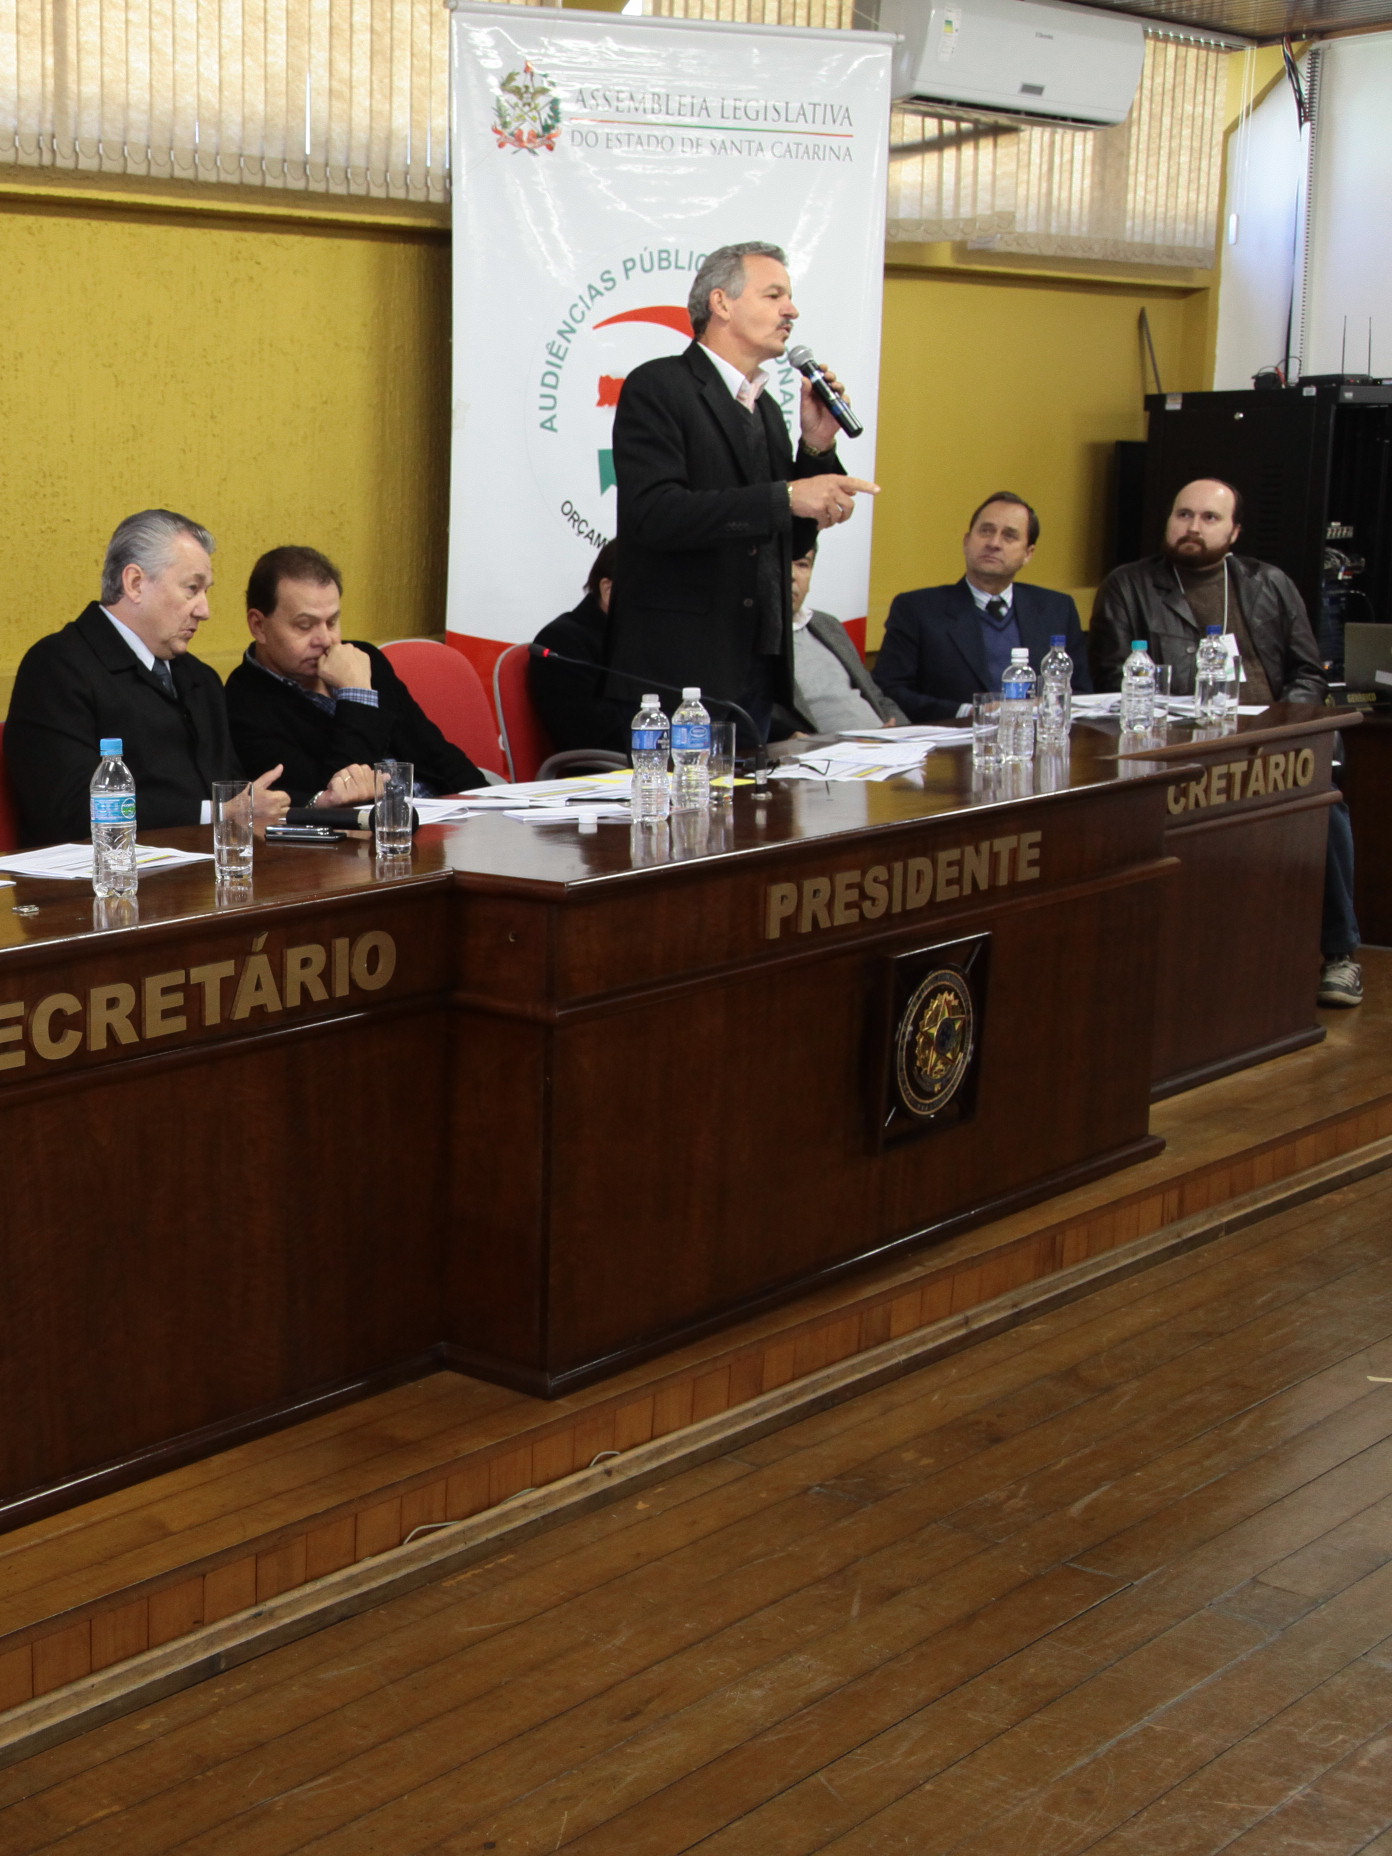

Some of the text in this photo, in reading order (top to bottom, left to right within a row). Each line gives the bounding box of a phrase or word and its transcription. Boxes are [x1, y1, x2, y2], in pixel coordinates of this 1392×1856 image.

[574, 88, 853, 127] ASSEMBLEIA LEGISLATIVA
[570, 129, 853, 162] DO ESTADO DE SANTA CATARINA
[539, 269, 617, 433] AUDIÊNCIAS
[765, 829, 1043, 940] PRESIDENTE
